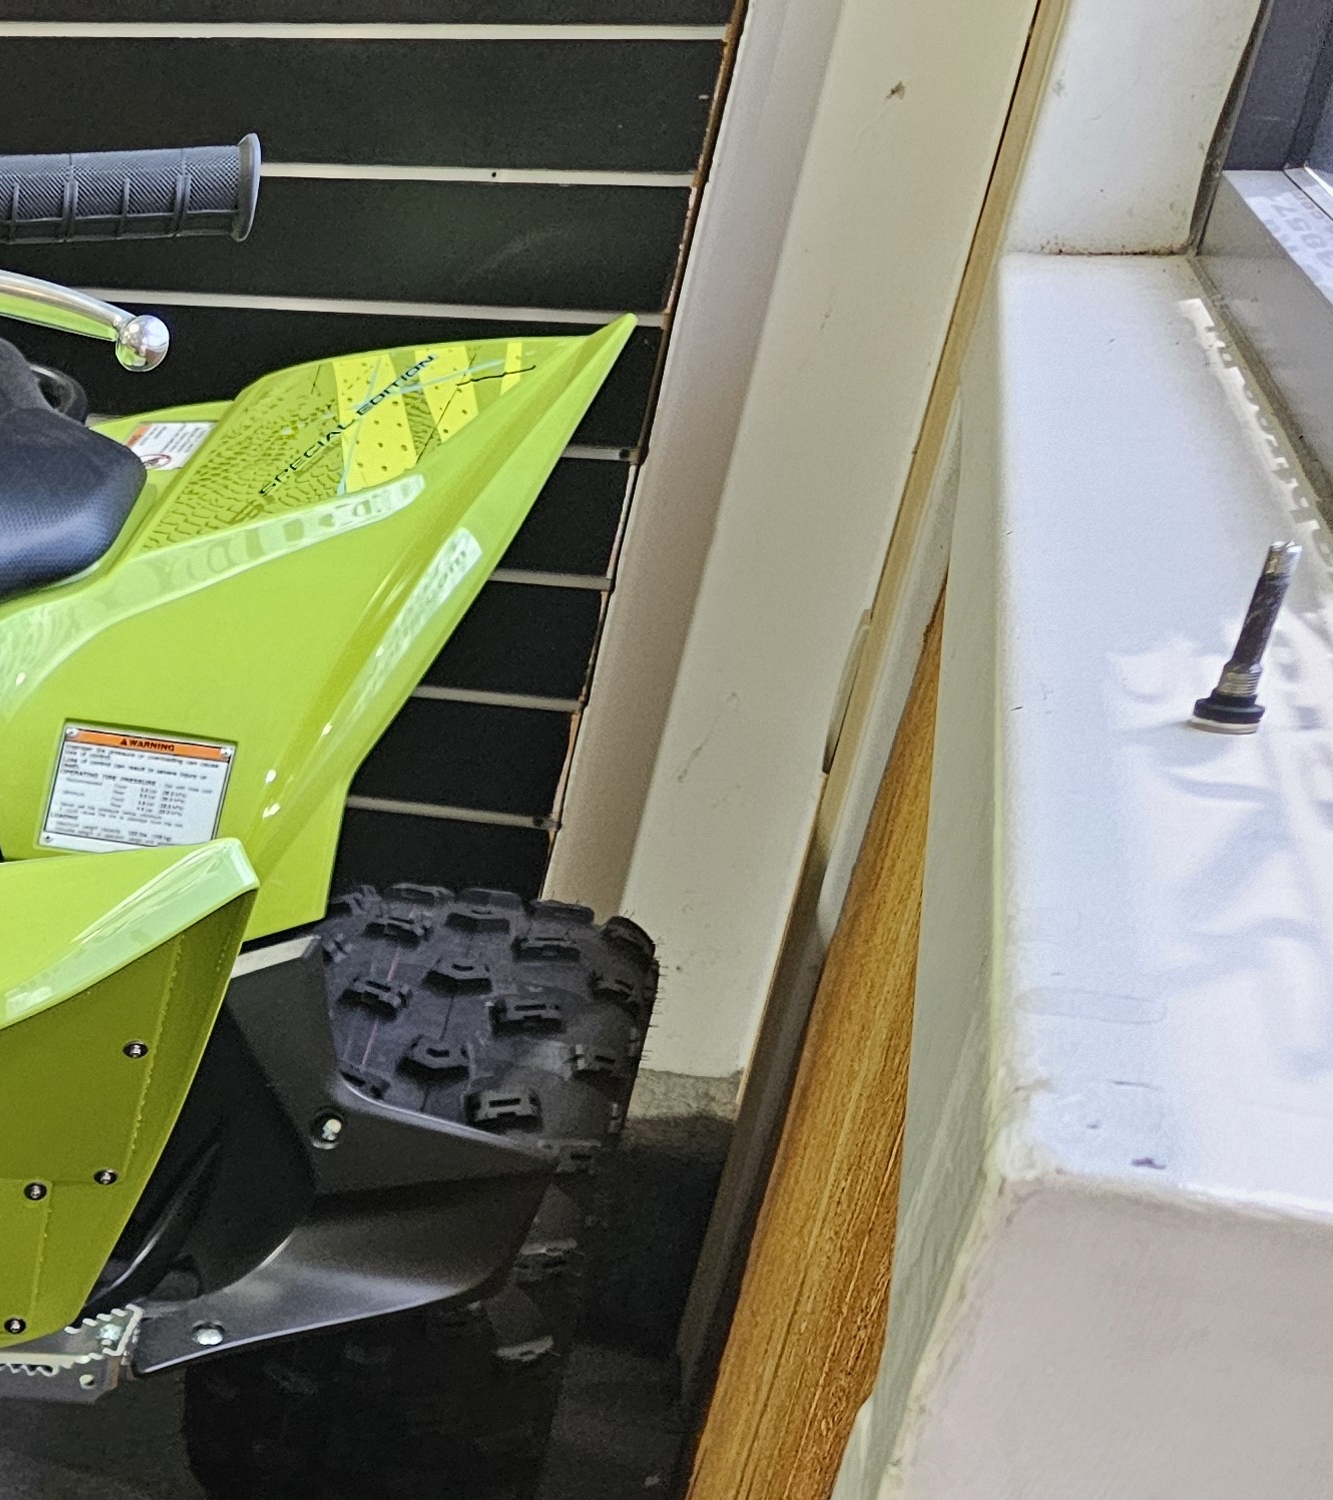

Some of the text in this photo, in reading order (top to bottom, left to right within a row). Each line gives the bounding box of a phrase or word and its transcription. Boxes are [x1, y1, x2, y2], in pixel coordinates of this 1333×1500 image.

[259, 421, 353, 495] SPECIAL
[356, 355, 435, 417] EDITION
[128, 739, 175, 751] WARNING
